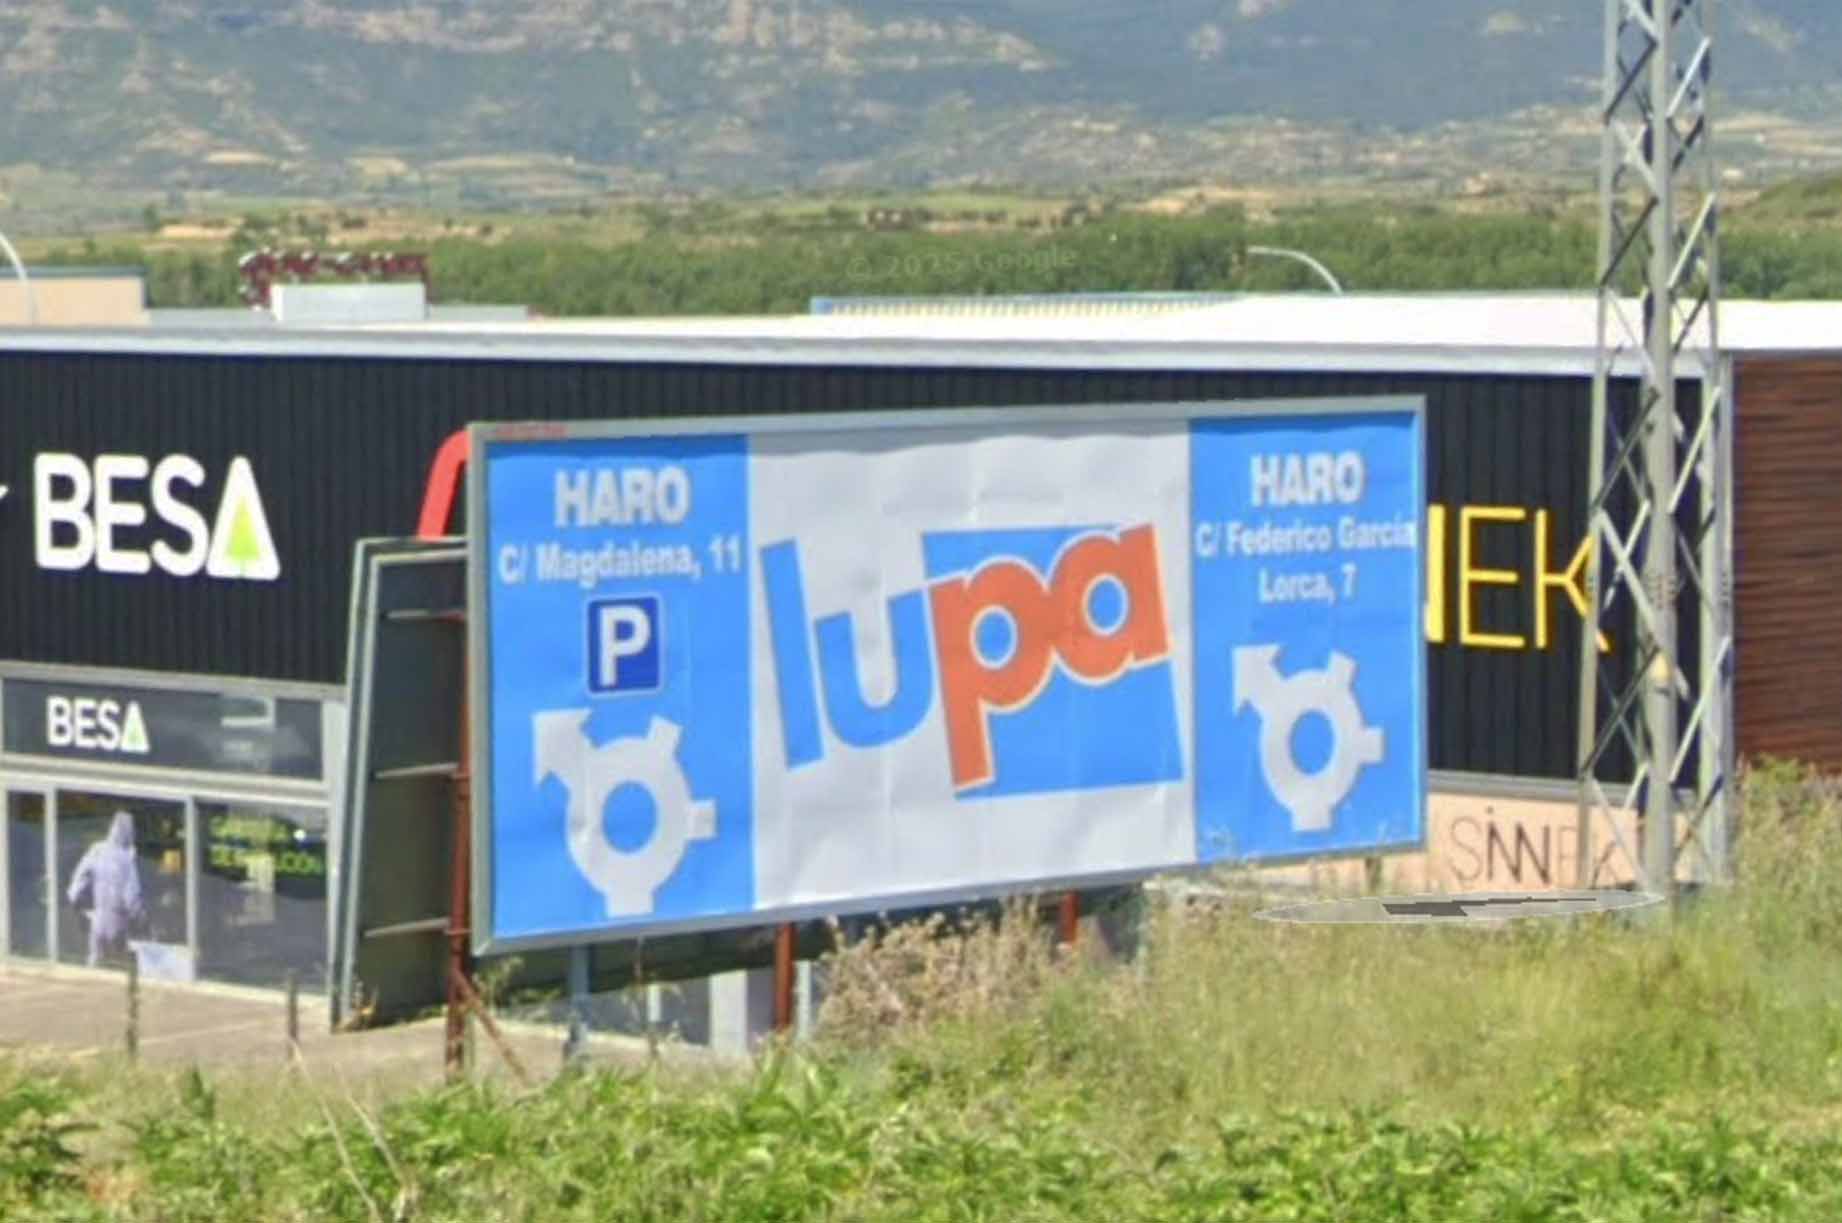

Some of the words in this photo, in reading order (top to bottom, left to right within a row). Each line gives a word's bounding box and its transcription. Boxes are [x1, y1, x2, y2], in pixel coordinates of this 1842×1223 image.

[554, 466, 690, 527] HARO
[1251, 450, 1365, 506] HARO
[34, 452, 281, 580] BESA
[1227, 519, 1333, 556] Federico
[499, 543, 528, 583] C/
[535, 540, 702, 588] Magdalena,
[709, 535, 740, 573] 11
[1258, 568, 1337, 606] Lorca,
[1341, 561, 1357, 598] 7
[599, 604, 651, 688] P
[758, 522, 1171, 790] lupa
[46, 695, 150, 753] BESA
